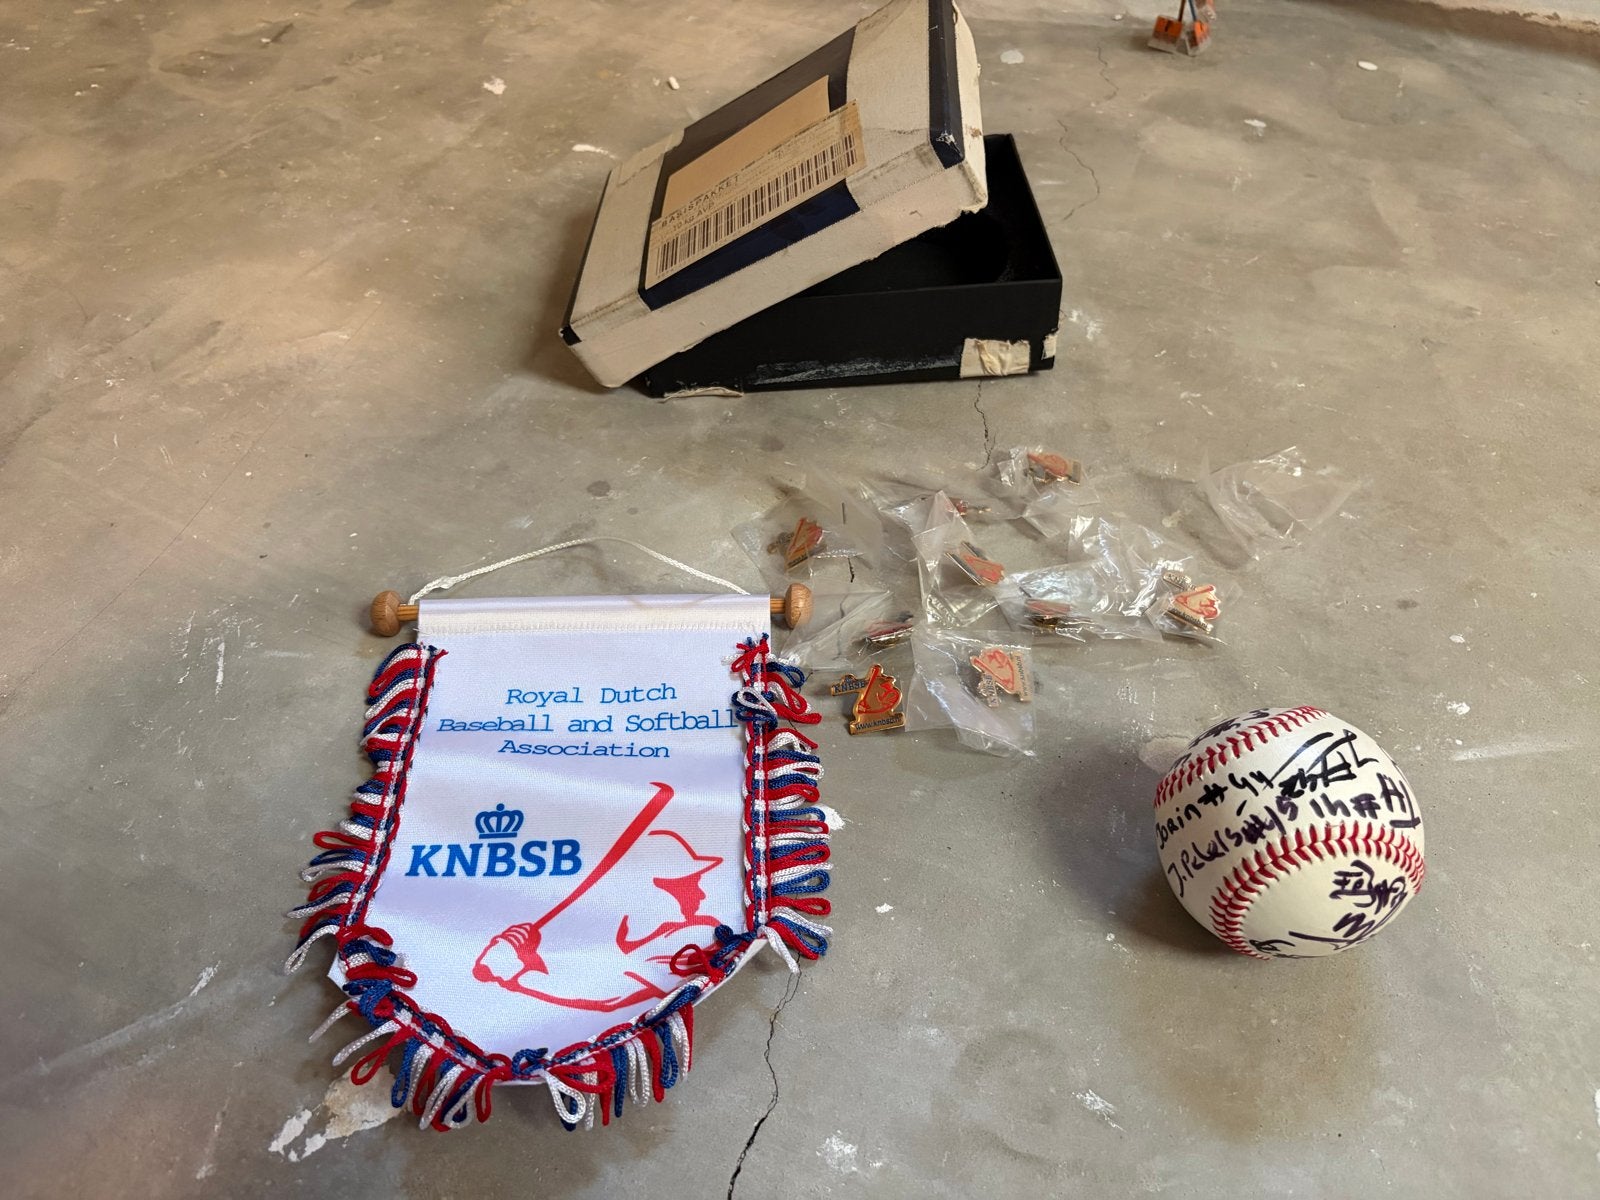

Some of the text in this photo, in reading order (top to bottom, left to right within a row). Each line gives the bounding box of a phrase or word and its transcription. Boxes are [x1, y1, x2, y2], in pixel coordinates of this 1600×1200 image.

[505, 683, 677, 707] Royal Dutch
[436, 709, 738, 733] Baseball and Softball
[498, 739, 670, 758] Association
[405, 838, 583, 877] KNBSB
